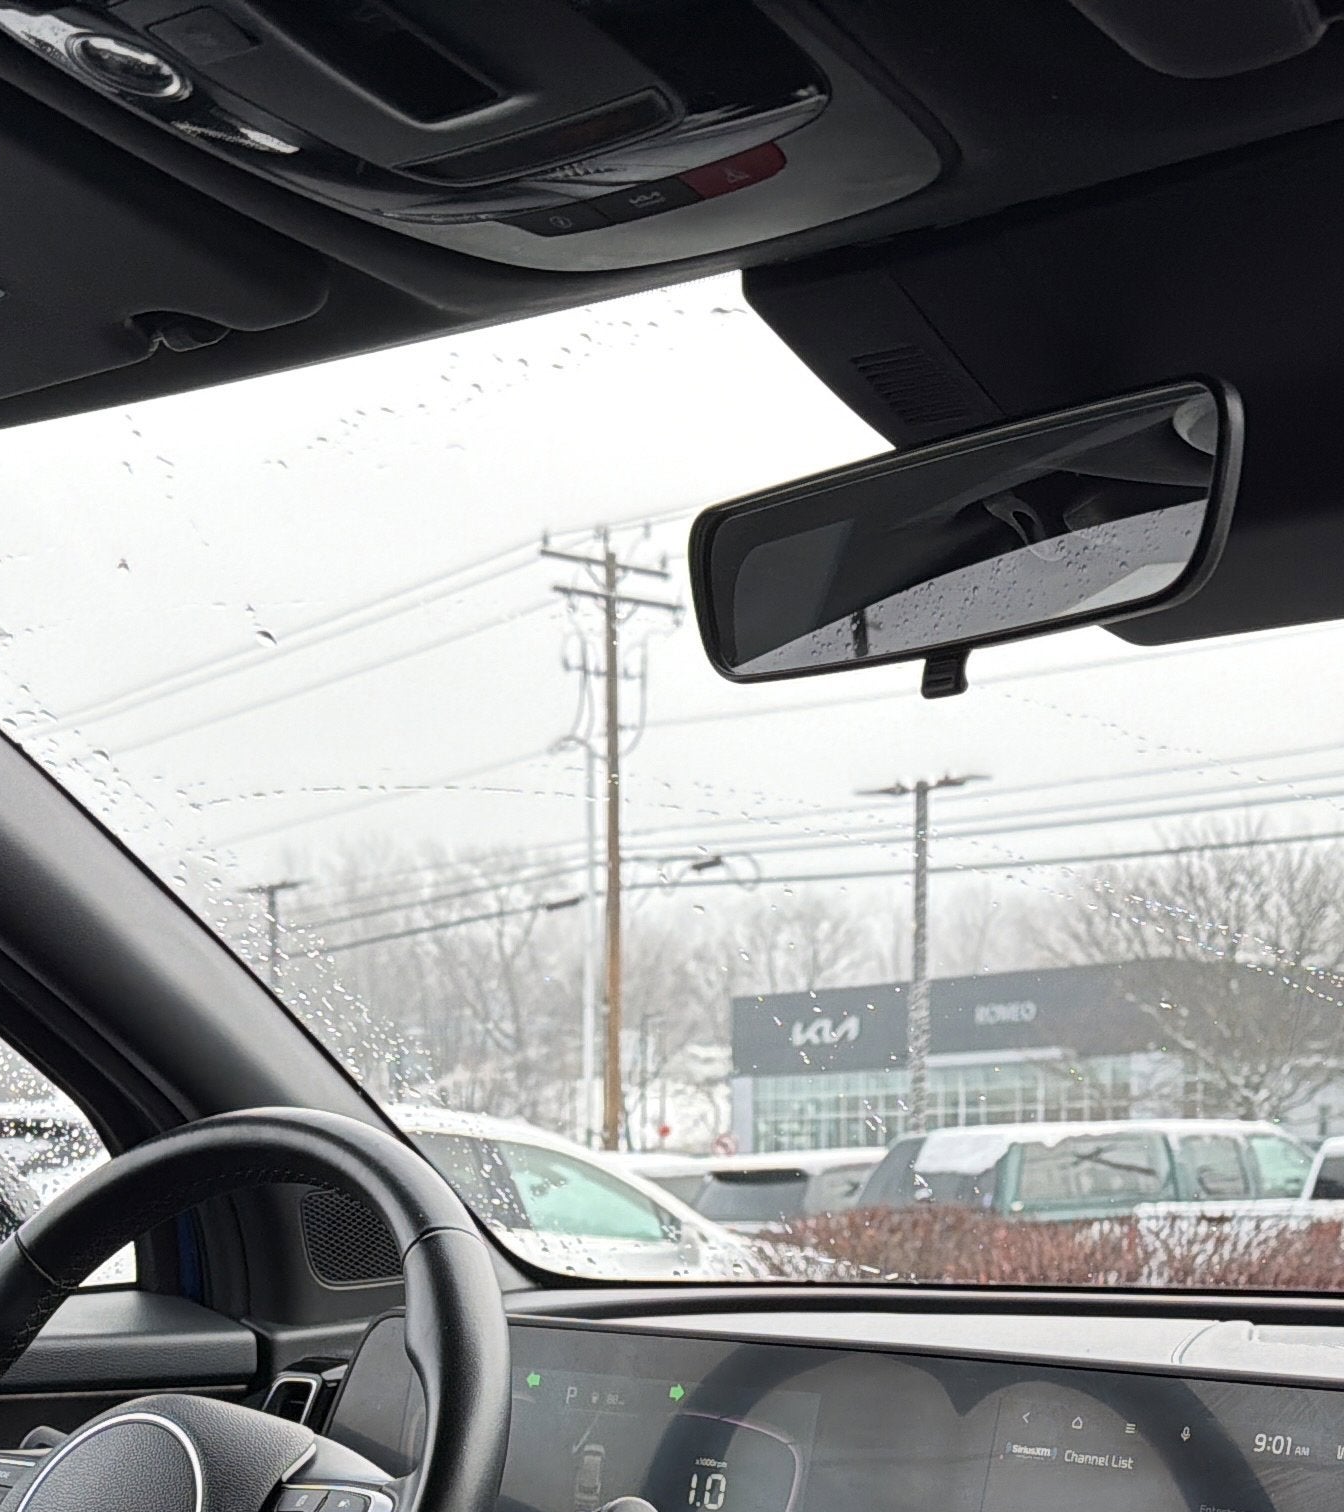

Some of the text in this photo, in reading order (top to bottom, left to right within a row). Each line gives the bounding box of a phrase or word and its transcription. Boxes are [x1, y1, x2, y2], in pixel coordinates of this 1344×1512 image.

[791, 1014, 861, 1048] KIA
[565, 1386, 577, 1405] P
[1253, 1432, 1293, 1456] 9:01
[1294, 1446, 1310, 1457] AM
[1064, 1449, 1109, 1467] Channel
[1111, 1454, 1135, 1470] List
[688, 1473, 727, 1510] 1.0
